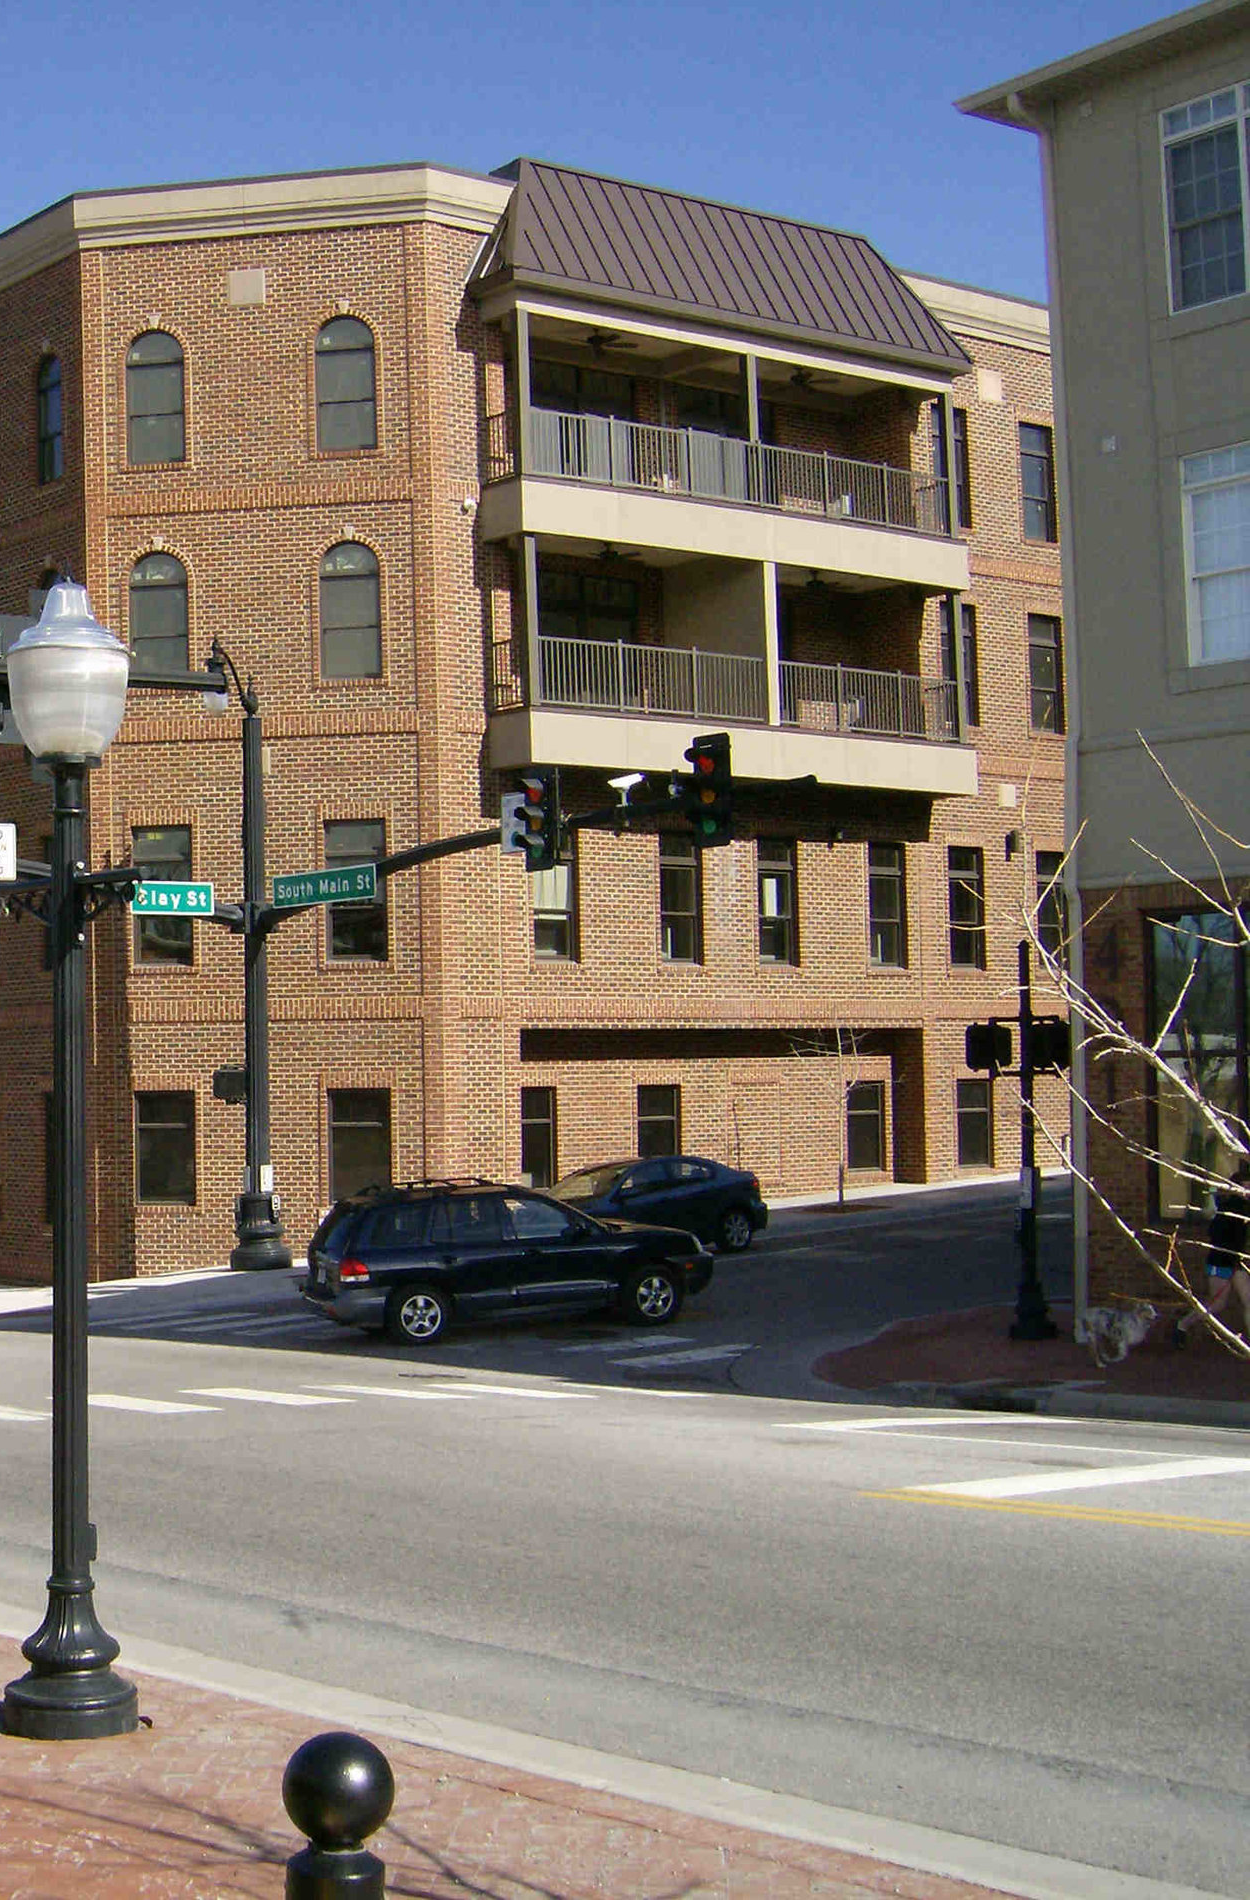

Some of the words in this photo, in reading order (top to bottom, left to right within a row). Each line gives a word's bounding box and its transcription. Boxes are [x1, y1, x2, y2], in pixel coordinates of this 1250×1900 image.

[137, 887, 181, 910] Clay
[187, 890, 206, 907] St
[278, 881, 313, 899] South
[319, 878, 349, 895] Main
[356, 874, 370, 890] St
